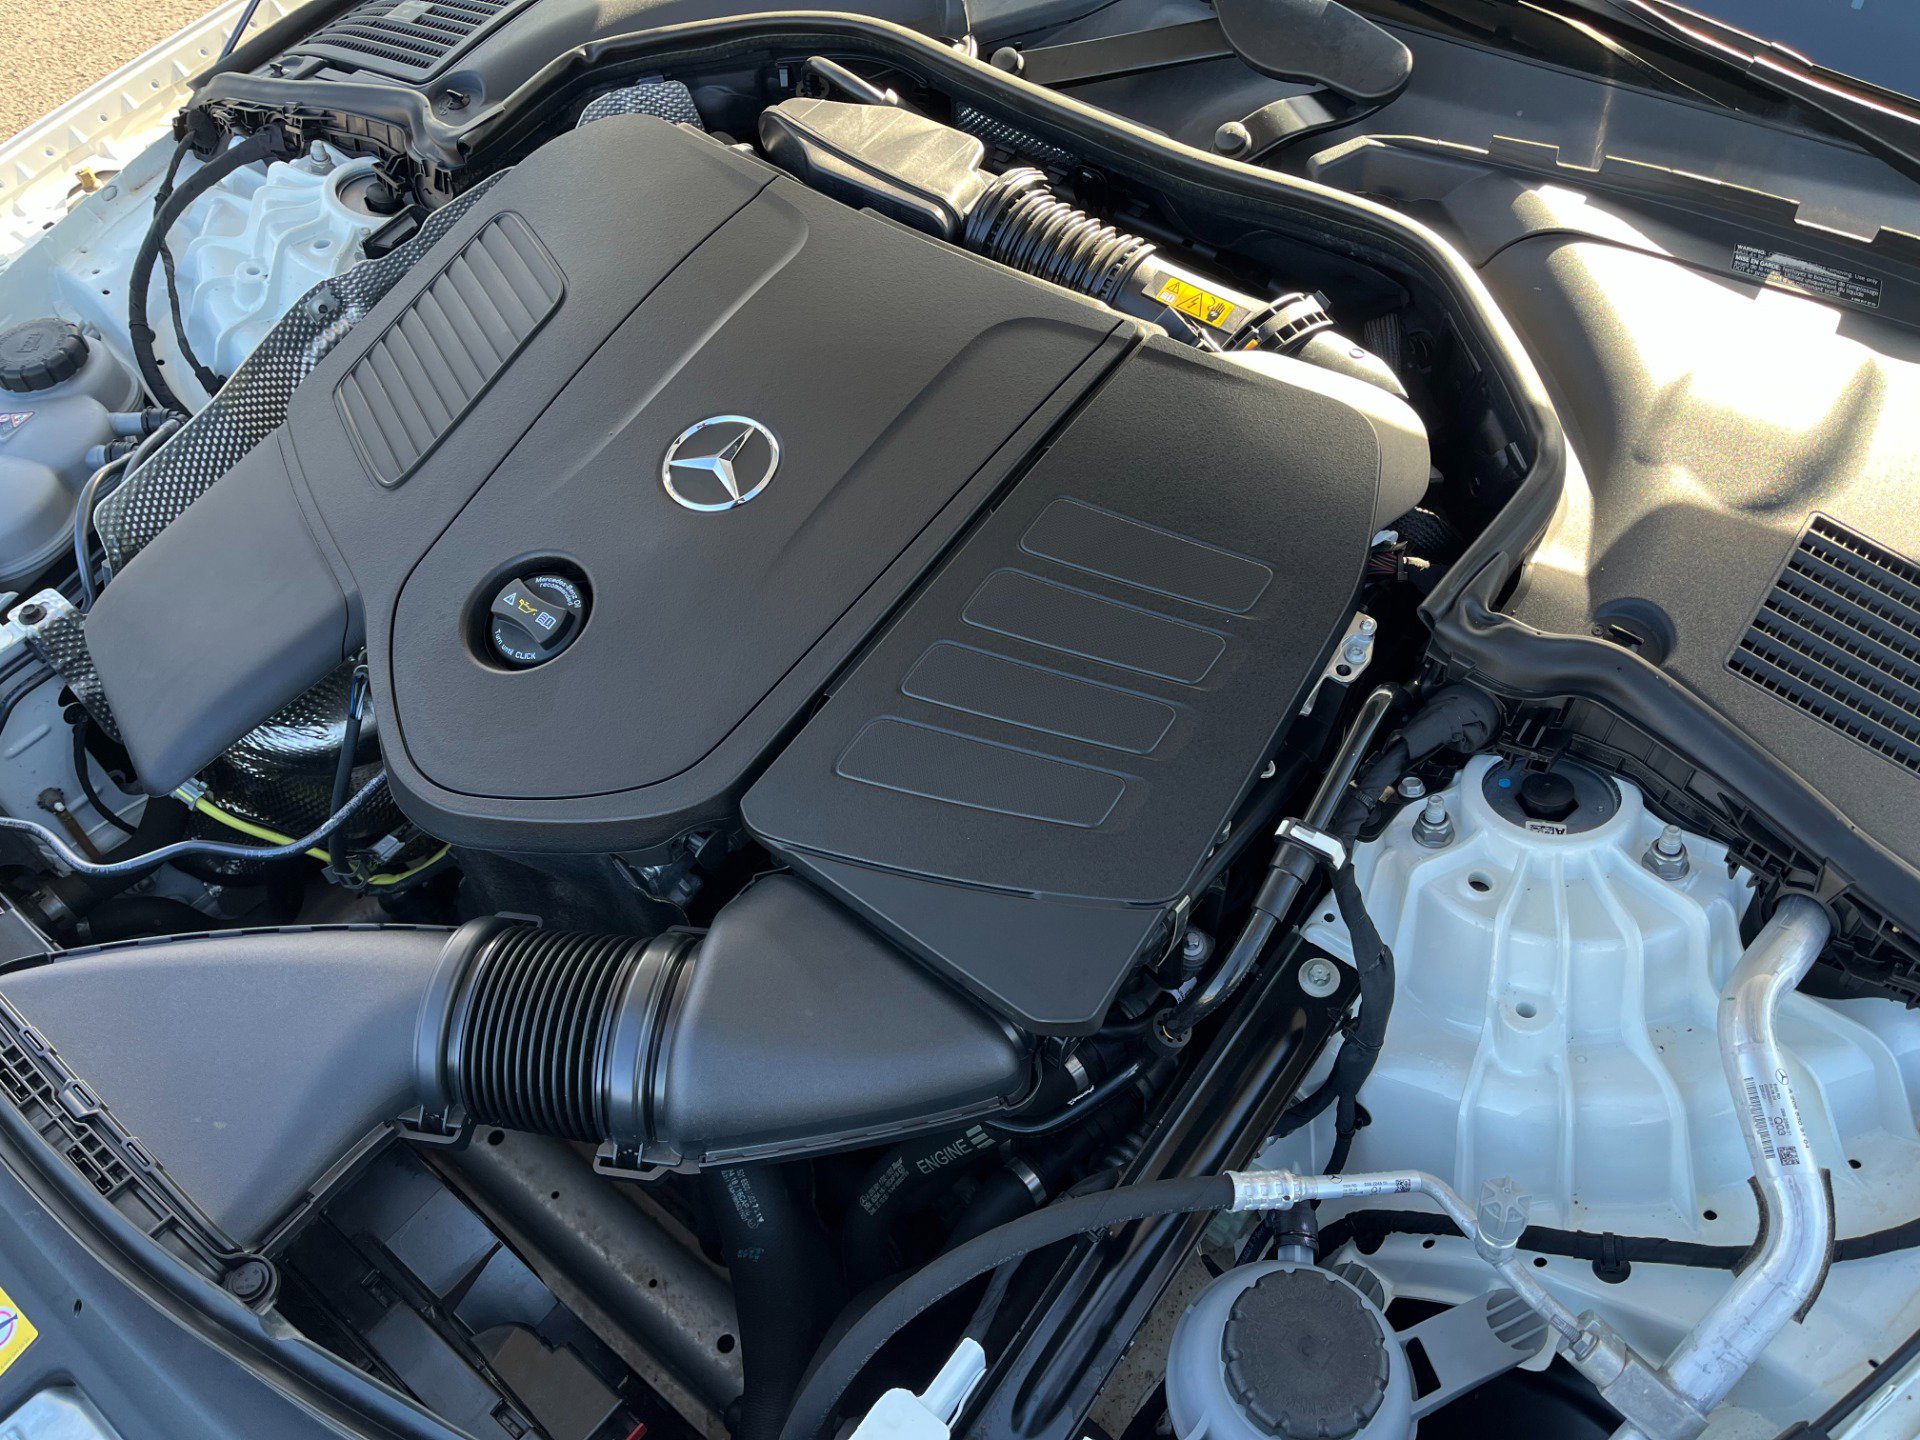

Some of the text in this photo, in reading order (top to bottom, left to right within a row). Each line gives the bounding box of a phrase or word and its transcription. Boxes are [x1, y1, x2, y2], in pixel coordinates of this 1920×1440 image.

[1735, 254, 1750, 263] MISE
[1866, 276, 1879, 285] only
[535, 577, 578, 599] Mercedes-Benz
[494, 628, 536, 660] Turn until CLICK
[916, 1138, 974, 1175] ENGINE
